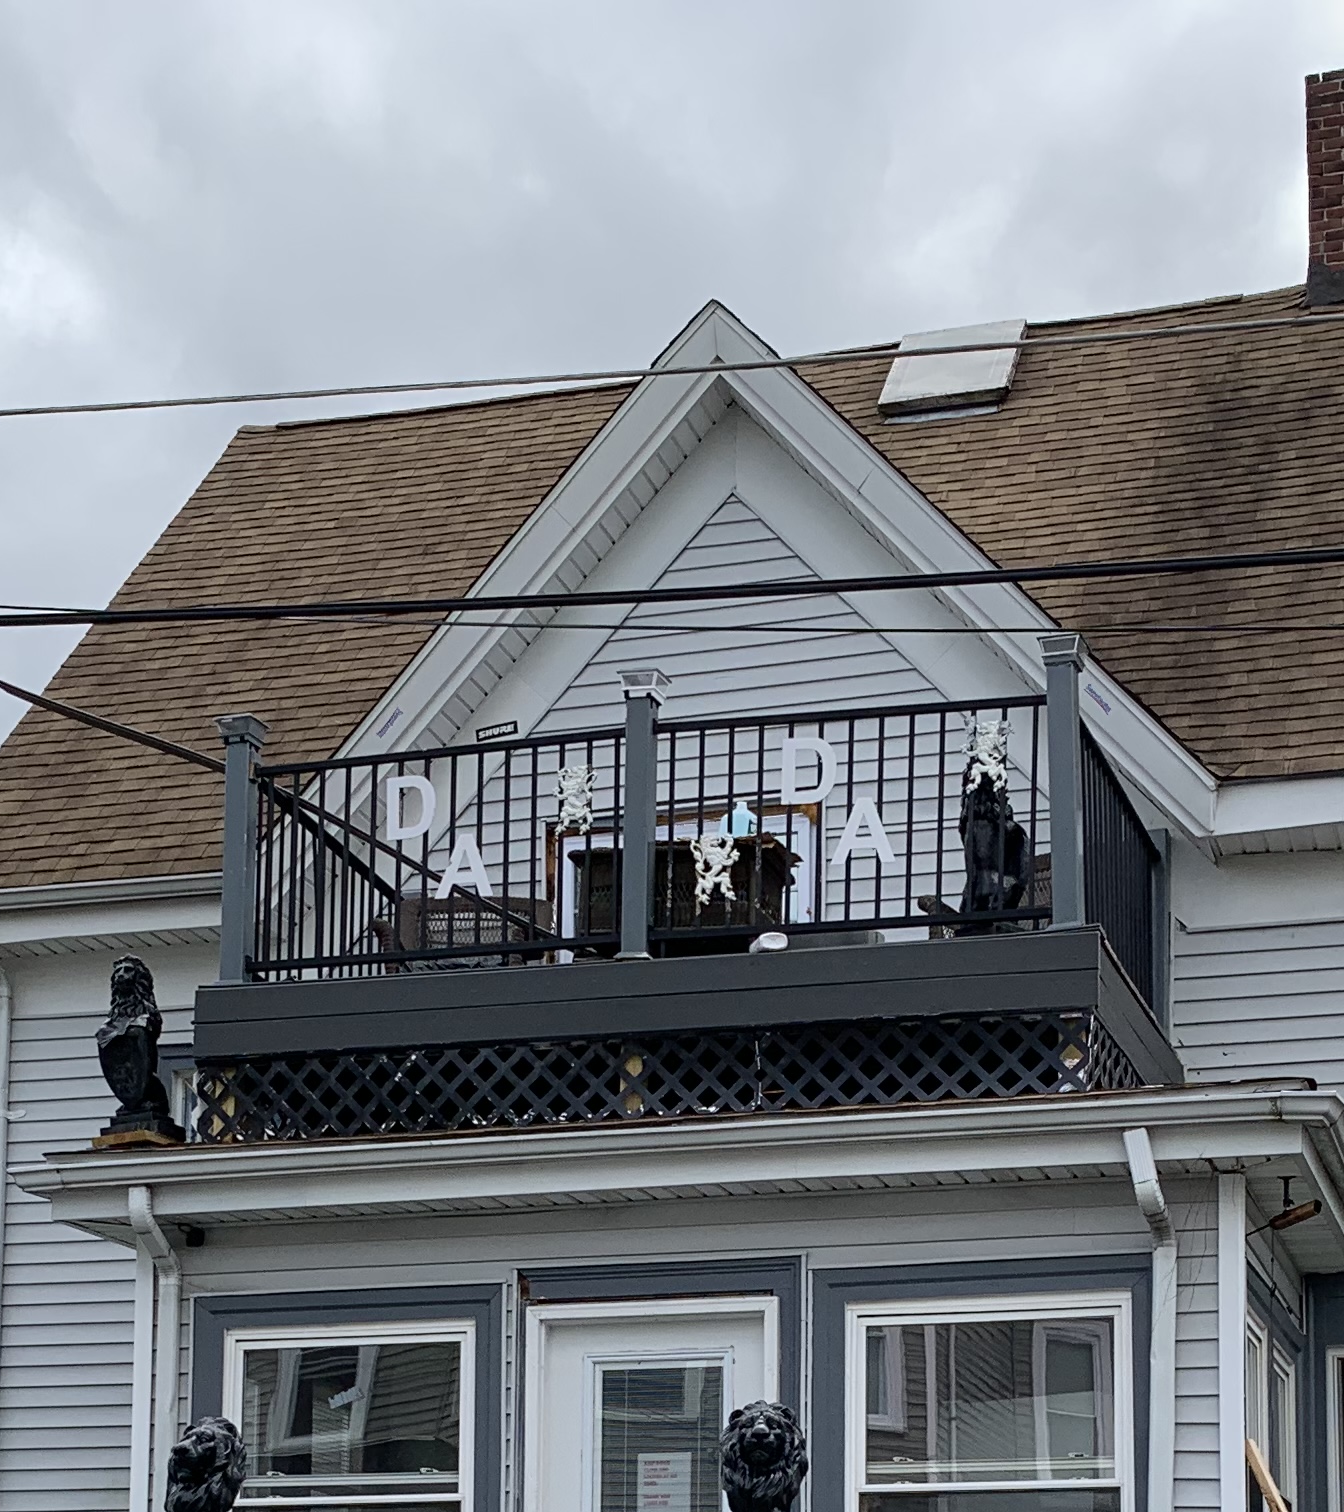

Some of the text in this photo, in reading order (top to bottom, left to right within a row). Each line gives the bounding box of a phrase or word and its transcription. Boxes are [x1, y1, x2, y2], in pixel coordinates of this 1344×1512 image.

[478, 723, 515, 740] SHURE
[386, 775, 436, 841] D
[434, 833, 494, 900] A
[780, 737, 896, 865] D A
